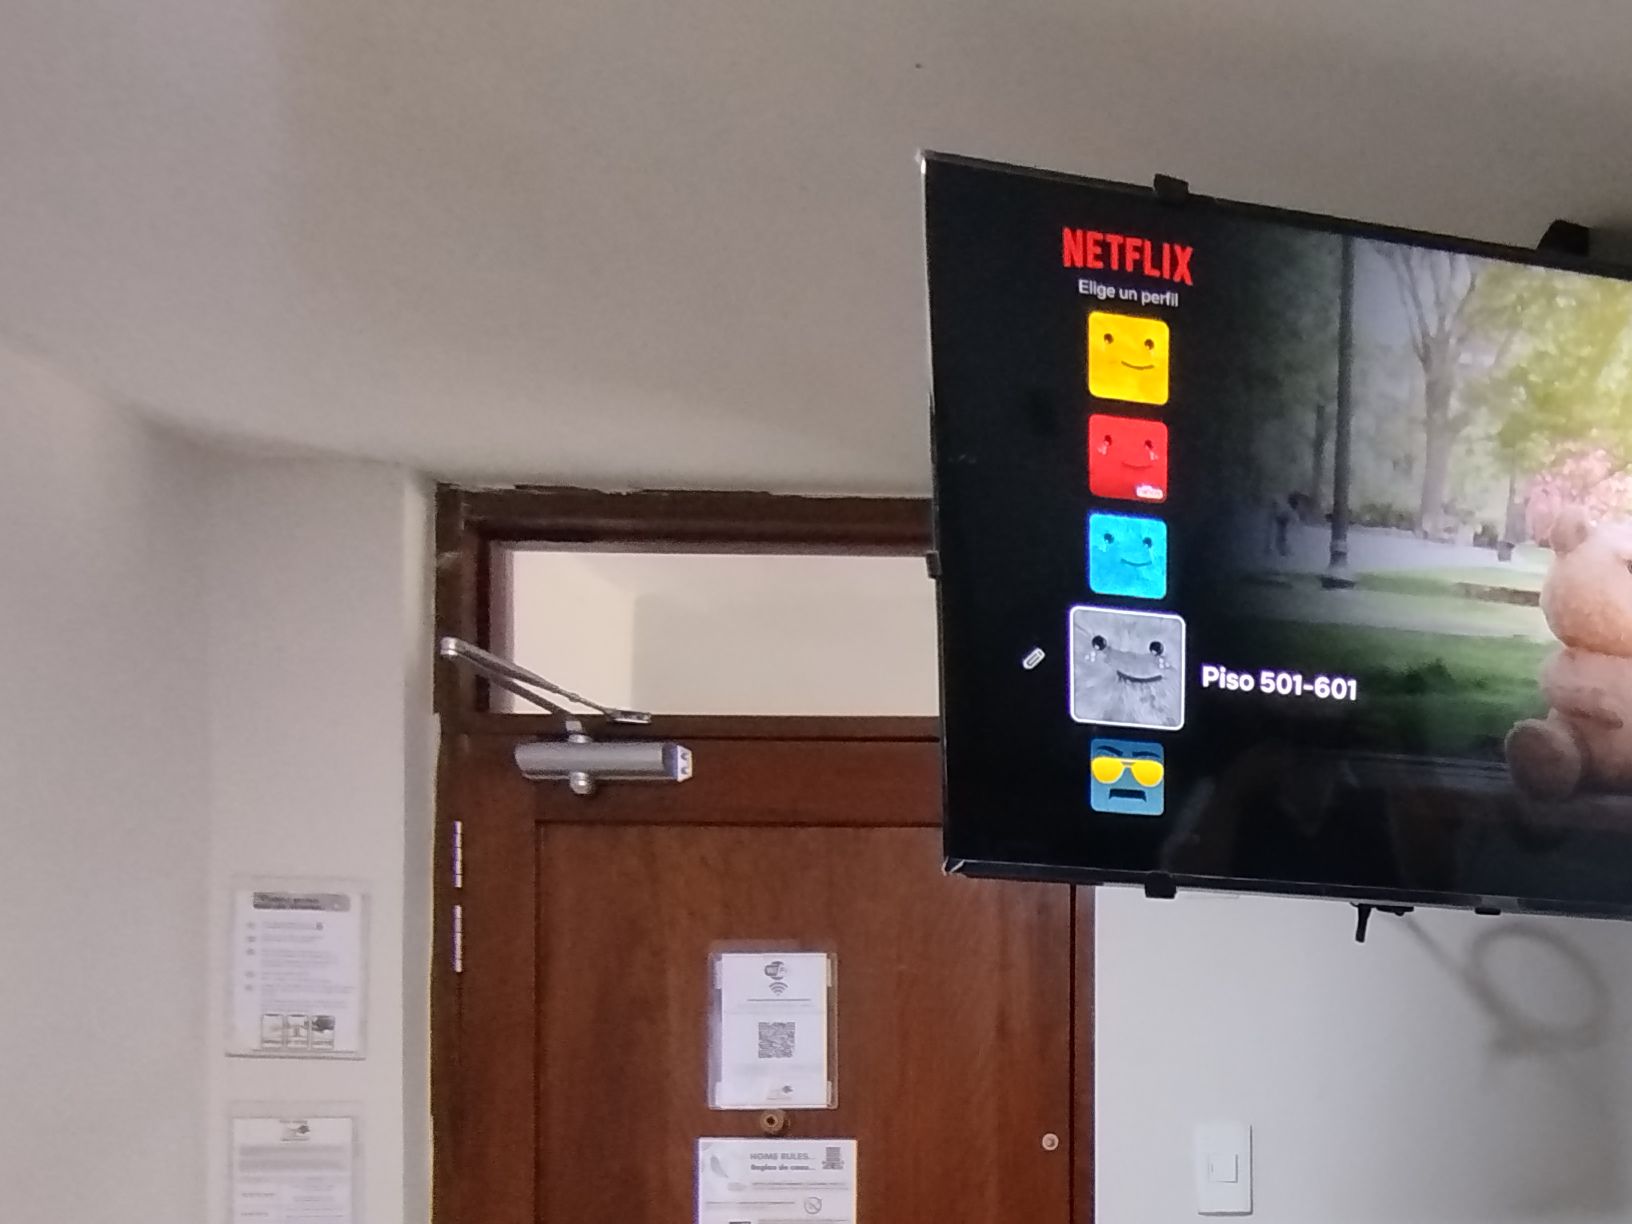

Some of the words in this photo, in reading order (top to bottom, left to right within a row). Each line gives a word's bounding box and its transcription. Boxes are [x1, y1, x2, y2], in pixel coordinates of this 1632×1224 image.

[1063, 227, 1193, 285] NETFLIX
[1078, 279, 1115, 300] Elige
[1119, 288, 1138, 301] un
[1141, 291, 1179, 307] perfil
[1202, 665, 1255, 692] Piso
[1260, 670, 1358, 701] 501-601
